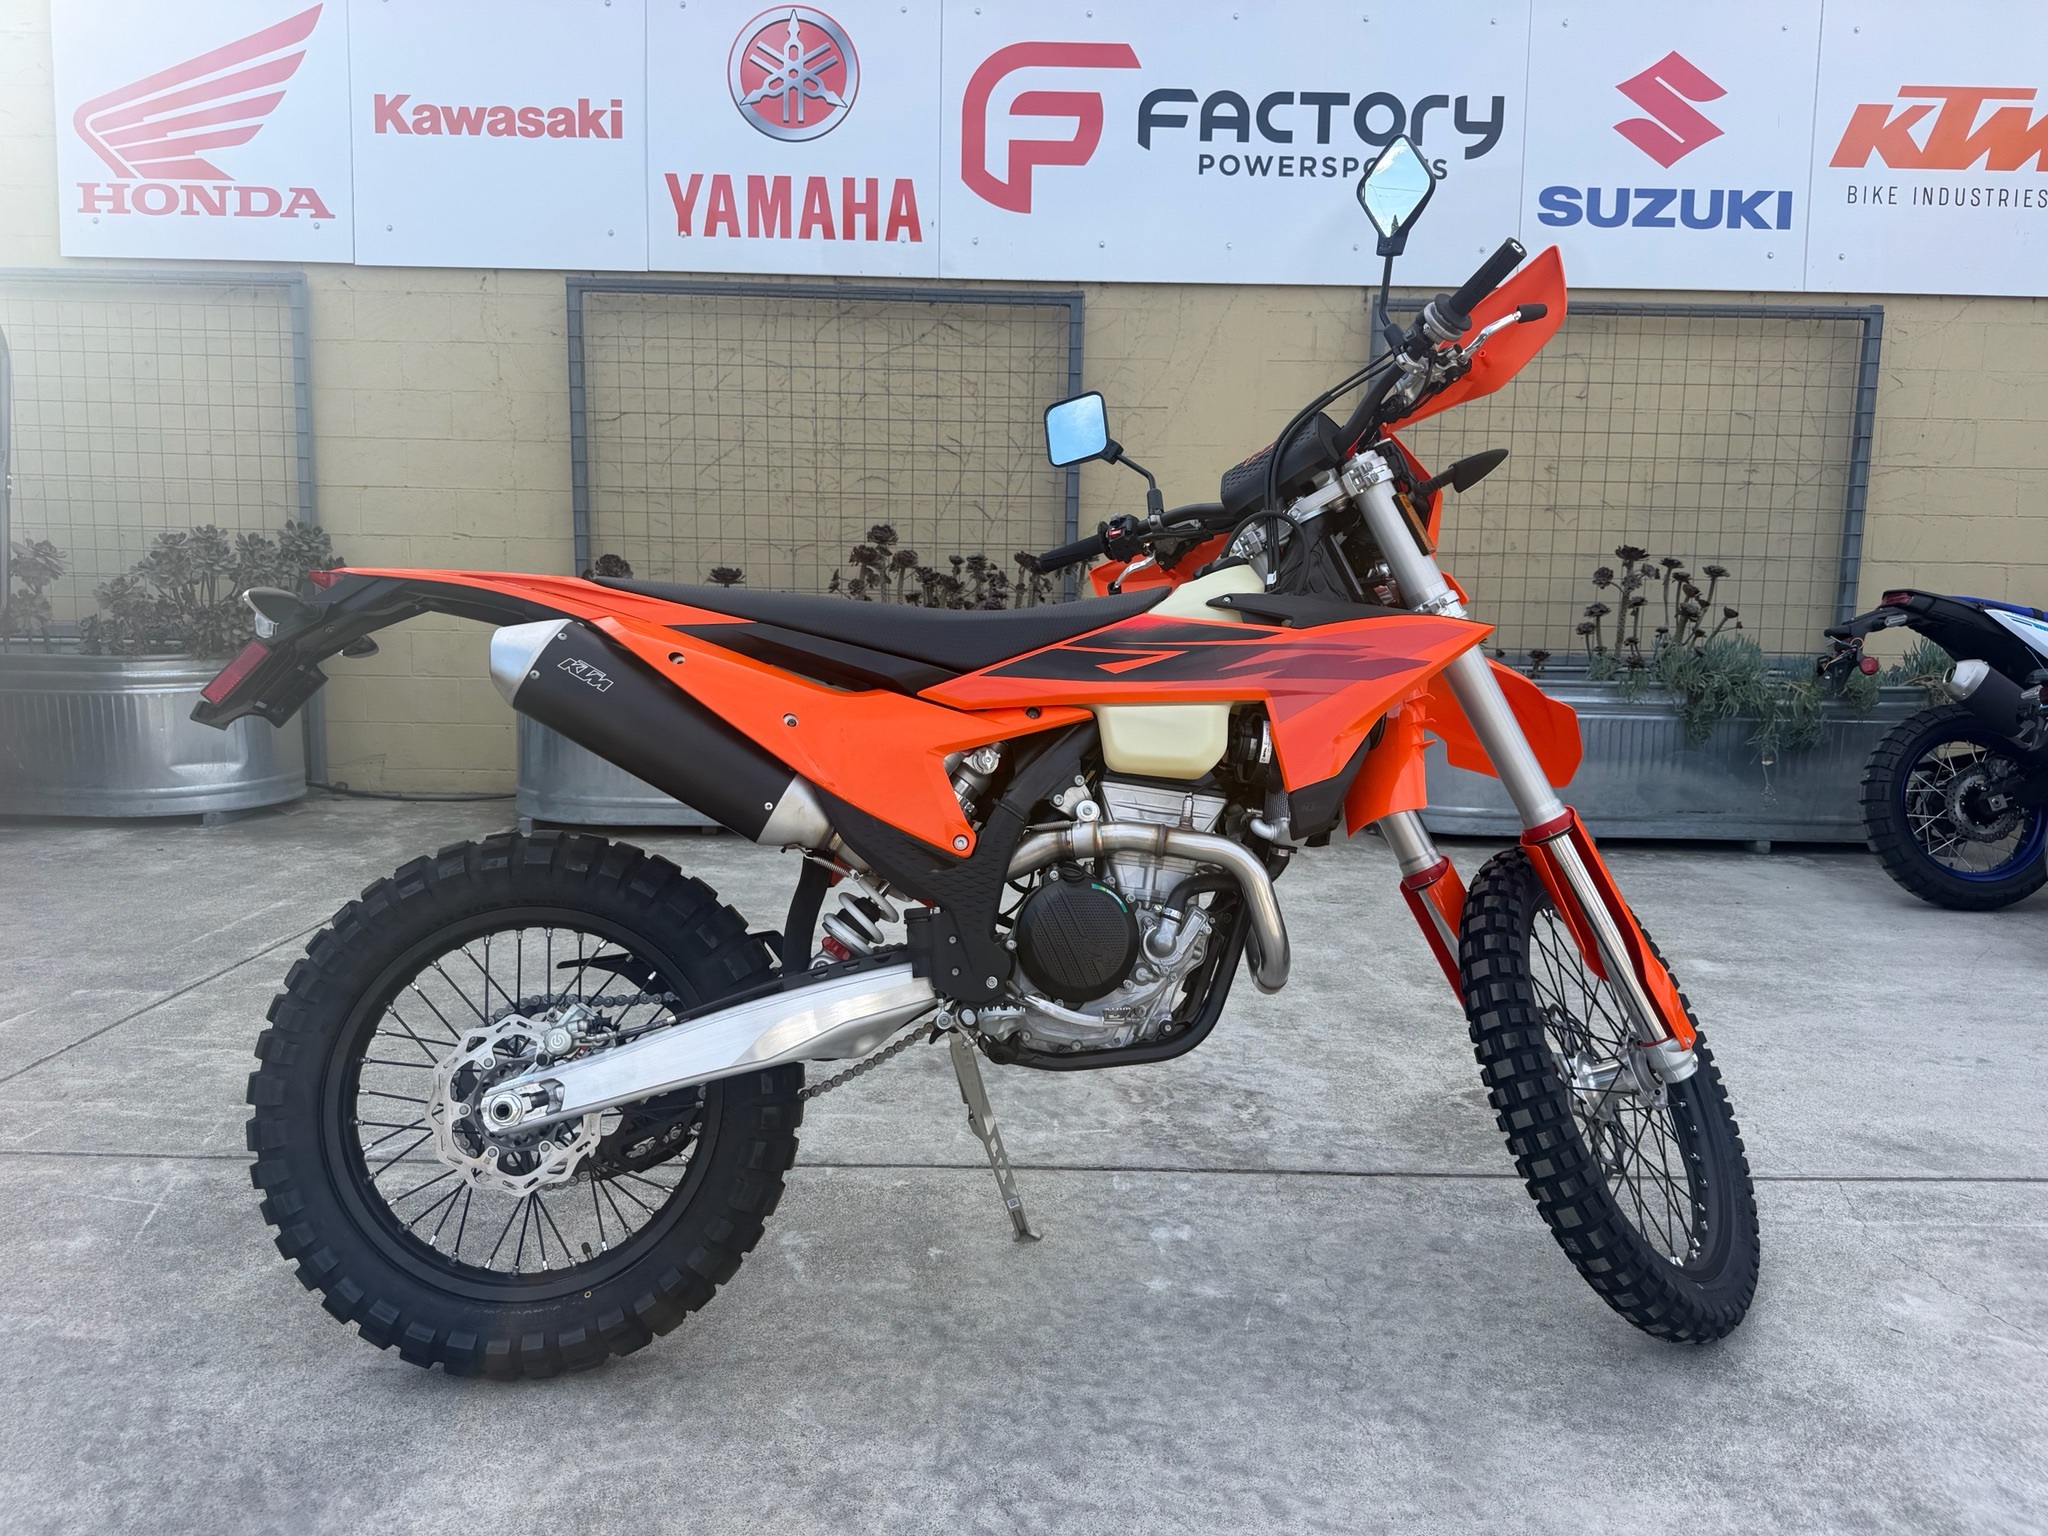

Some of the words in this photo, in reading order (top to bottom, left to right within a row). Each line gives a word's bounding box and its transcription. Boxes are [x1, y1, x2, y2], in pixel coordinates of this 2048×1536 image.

[374, 94, 623, 139] Kawasaki
[1828, 85, 2048, 172] KTM
[1198, 154, 1448, 180] POWERSPS
[77, 182, 336, 220] HONDA
[665, 173, 923, 243] YAMAHA
[1537, 185, 1793, 230] SUZUKI
[1847, 185, 1898, 205] BIKE
[1913, 187, 2048, 208] INDUSTRIES
[557, 657, 614, 693] KTM
